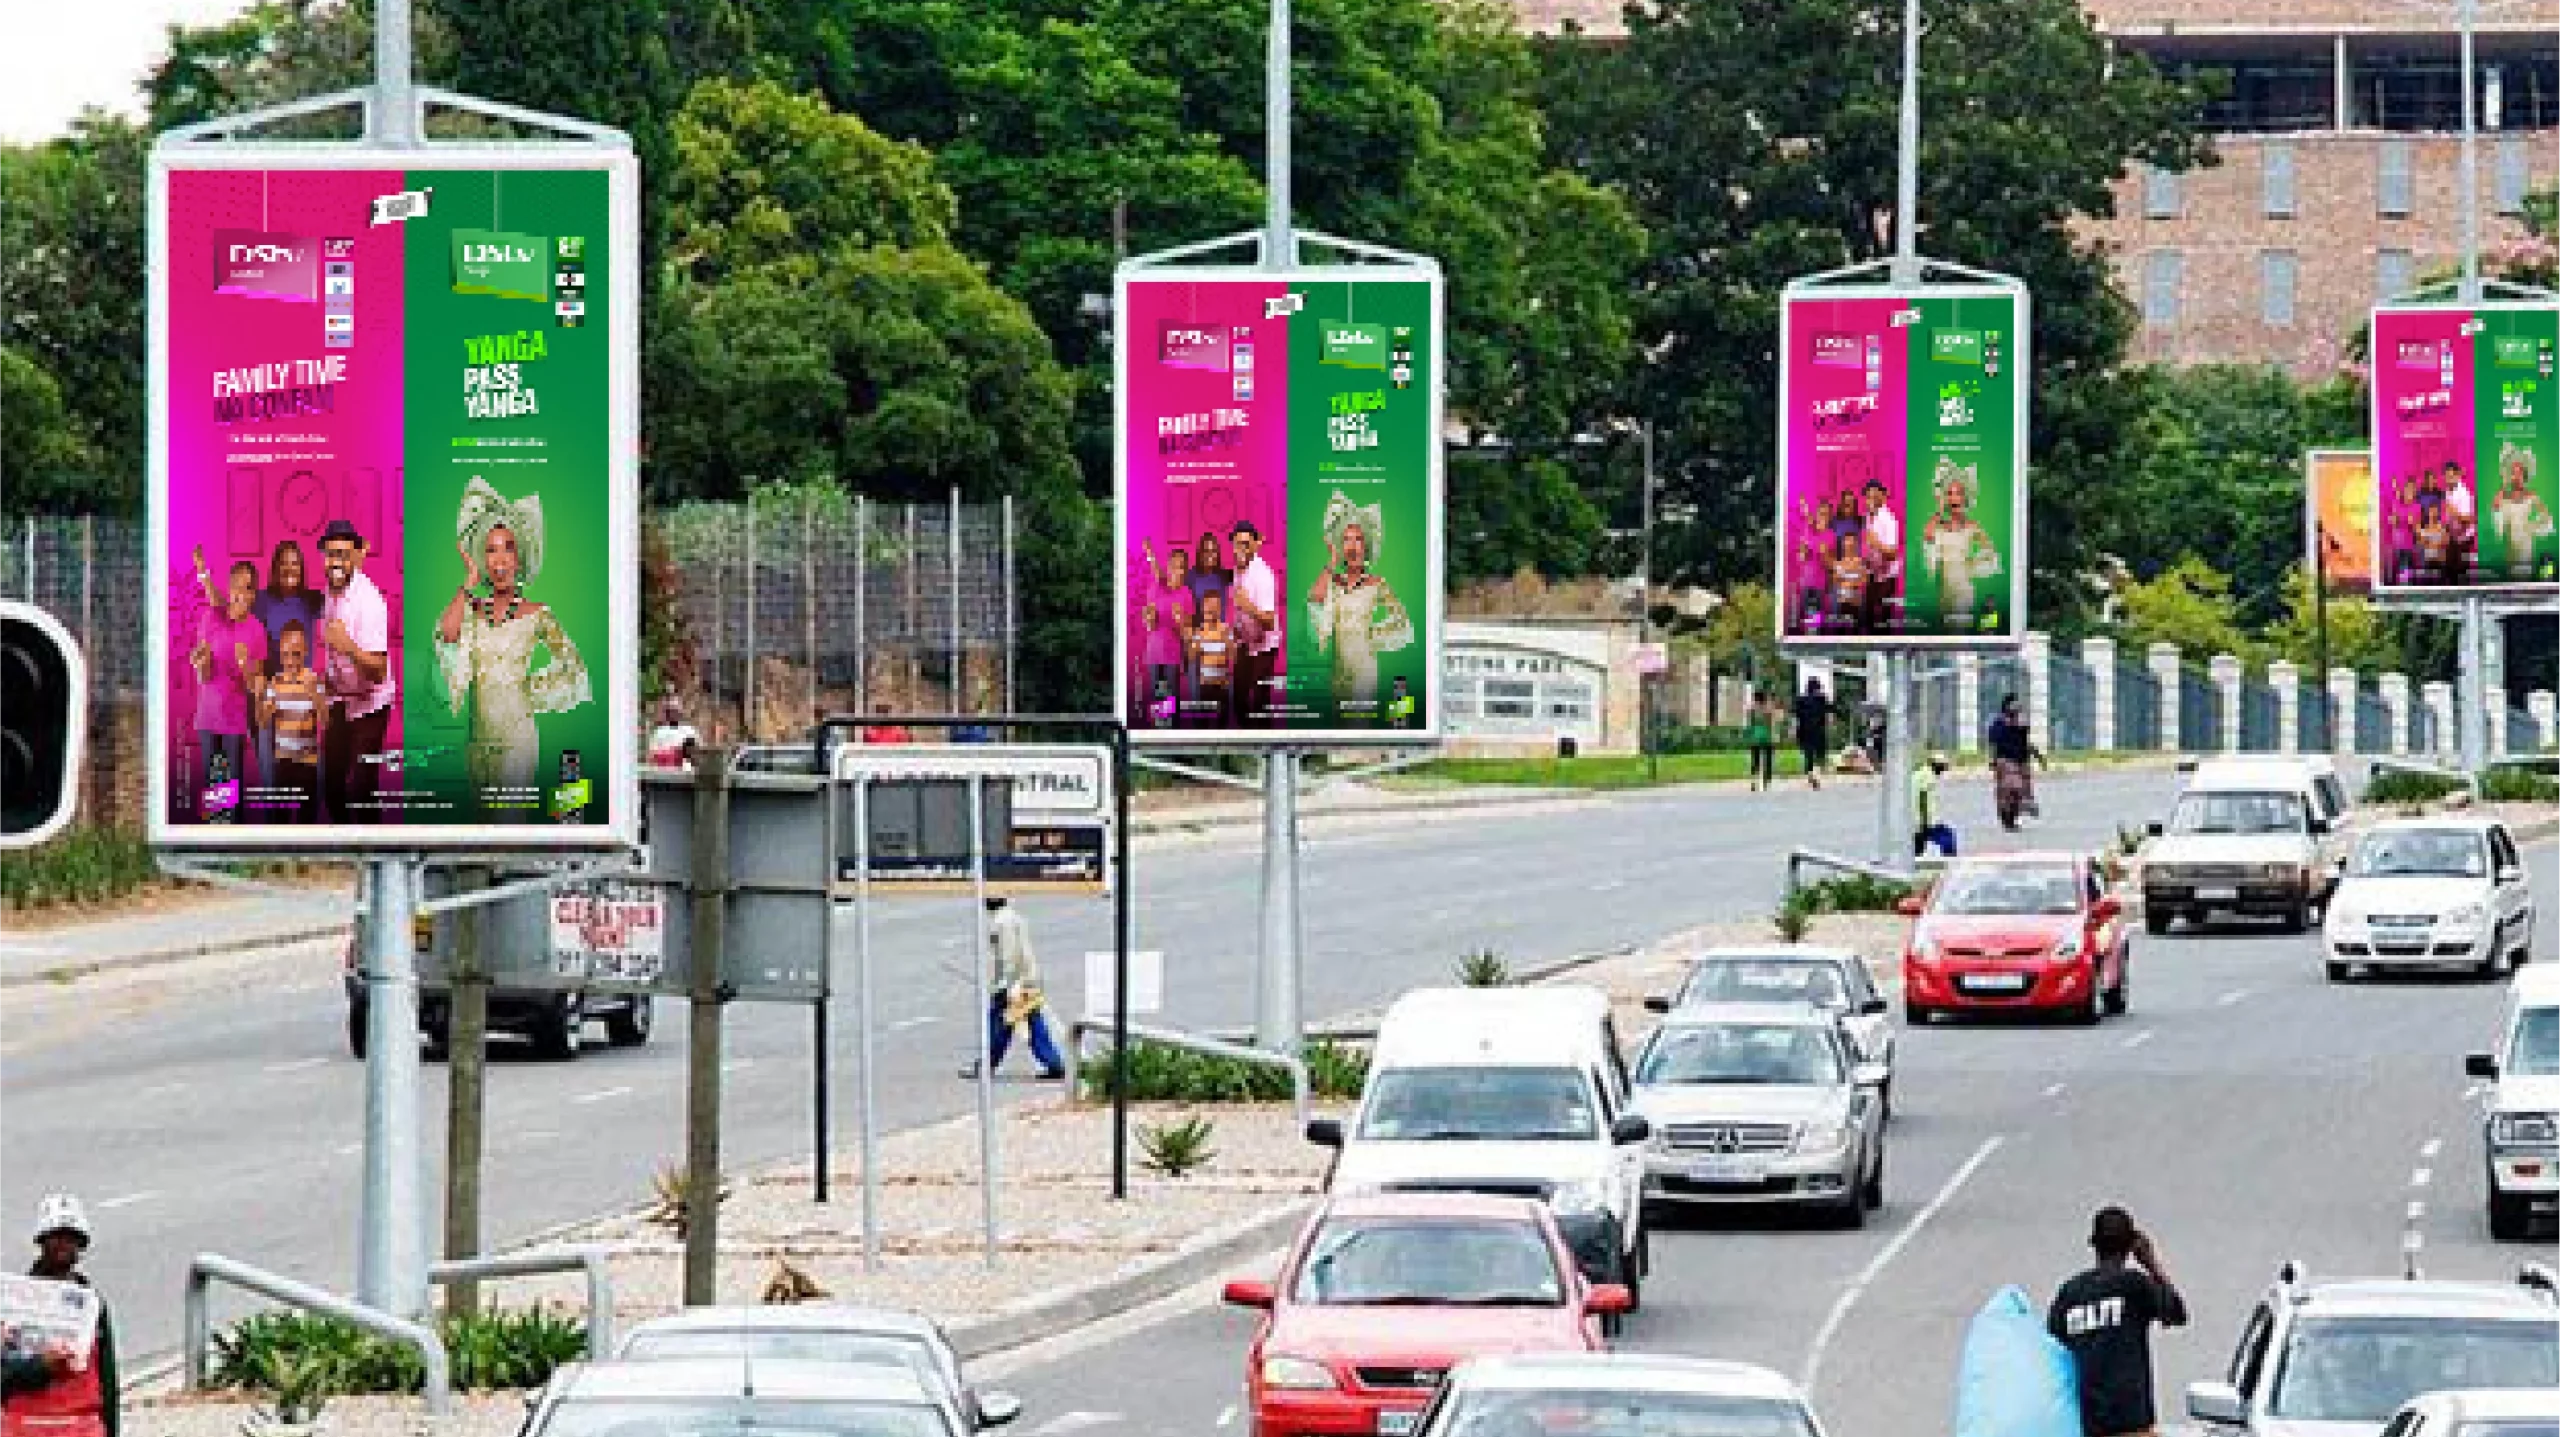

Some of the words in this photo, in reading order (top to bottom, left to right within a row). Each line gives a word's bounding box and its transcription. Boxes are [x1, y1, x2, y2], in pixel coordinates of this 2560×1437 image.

[463, 330, 548, 364] YANGA
[213, 363, 289, 398] FAMILY
[463, 363, 522, 393] PASS
